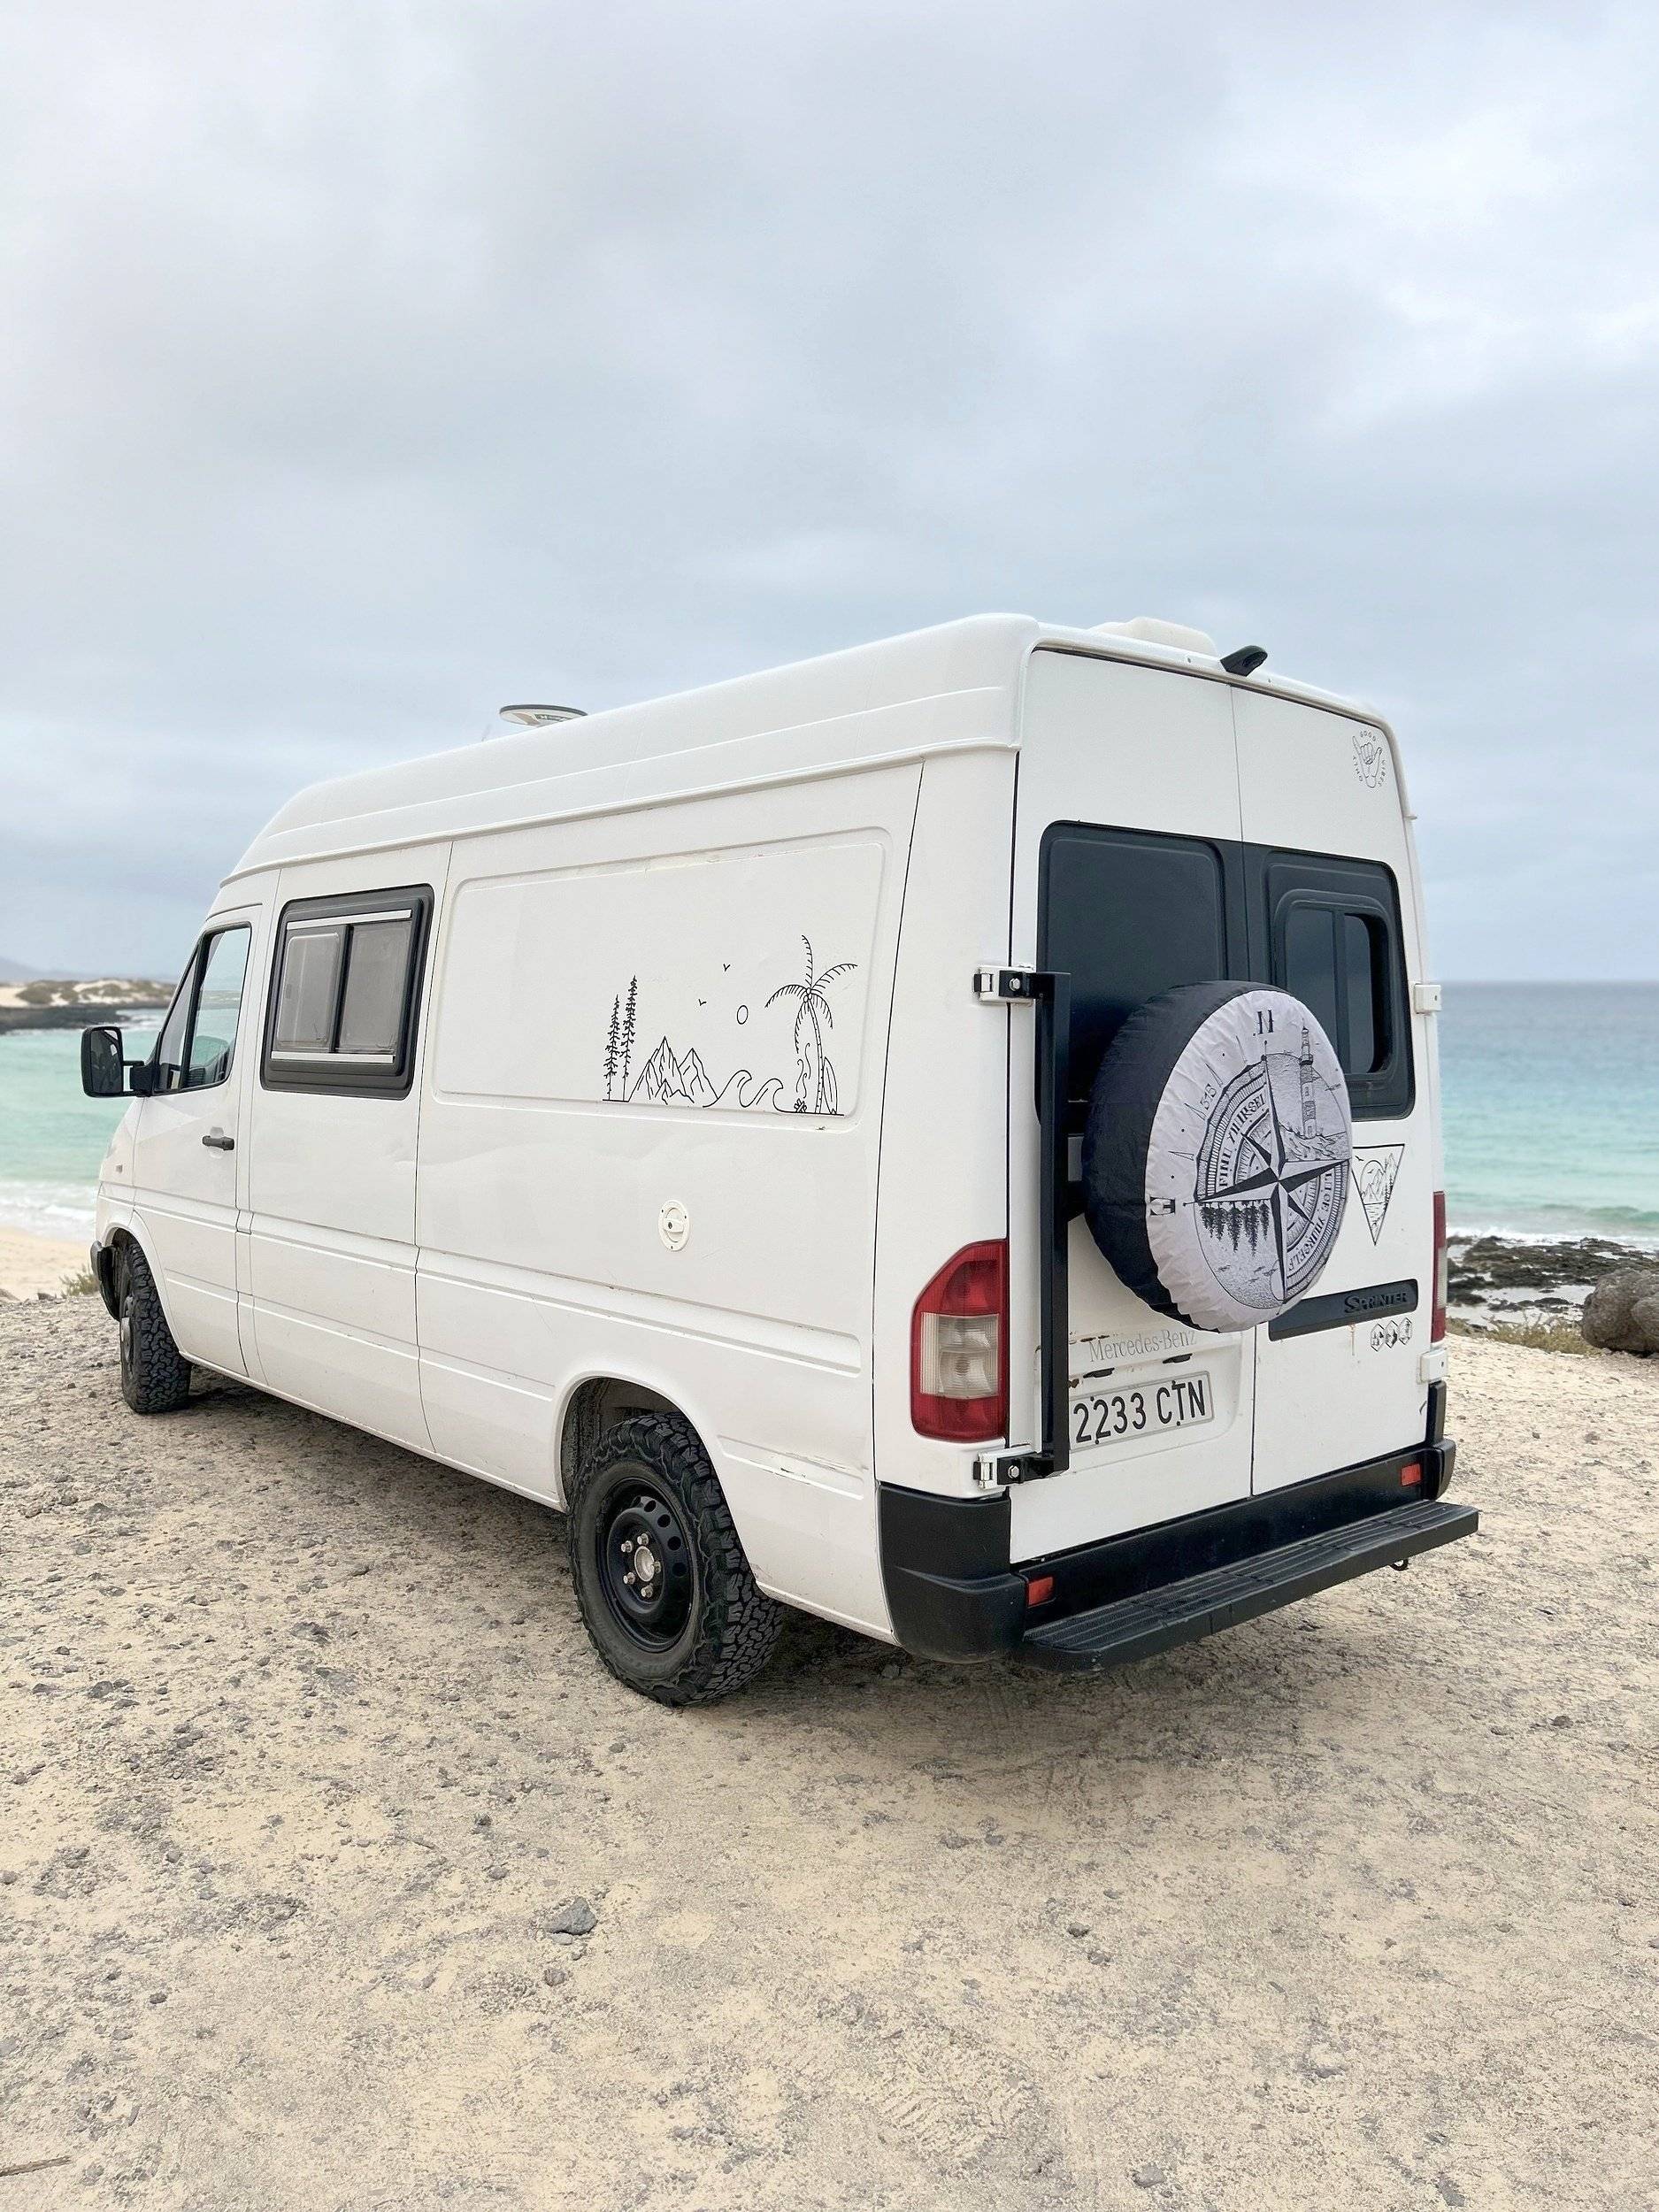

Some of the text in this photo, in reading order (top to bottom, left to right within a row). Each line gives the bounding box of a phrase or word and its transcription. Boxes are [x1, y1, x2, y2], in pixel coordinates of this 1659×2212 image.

[1226, 1092, 1267, 1143] YOURSEL
[1344, 1293, 1407, 1313] SPRINTER
[1089, 1330, 1197, 1363] Mercedes-Benz
[1073, 1379, 1206, 1443] 2233 CTN
